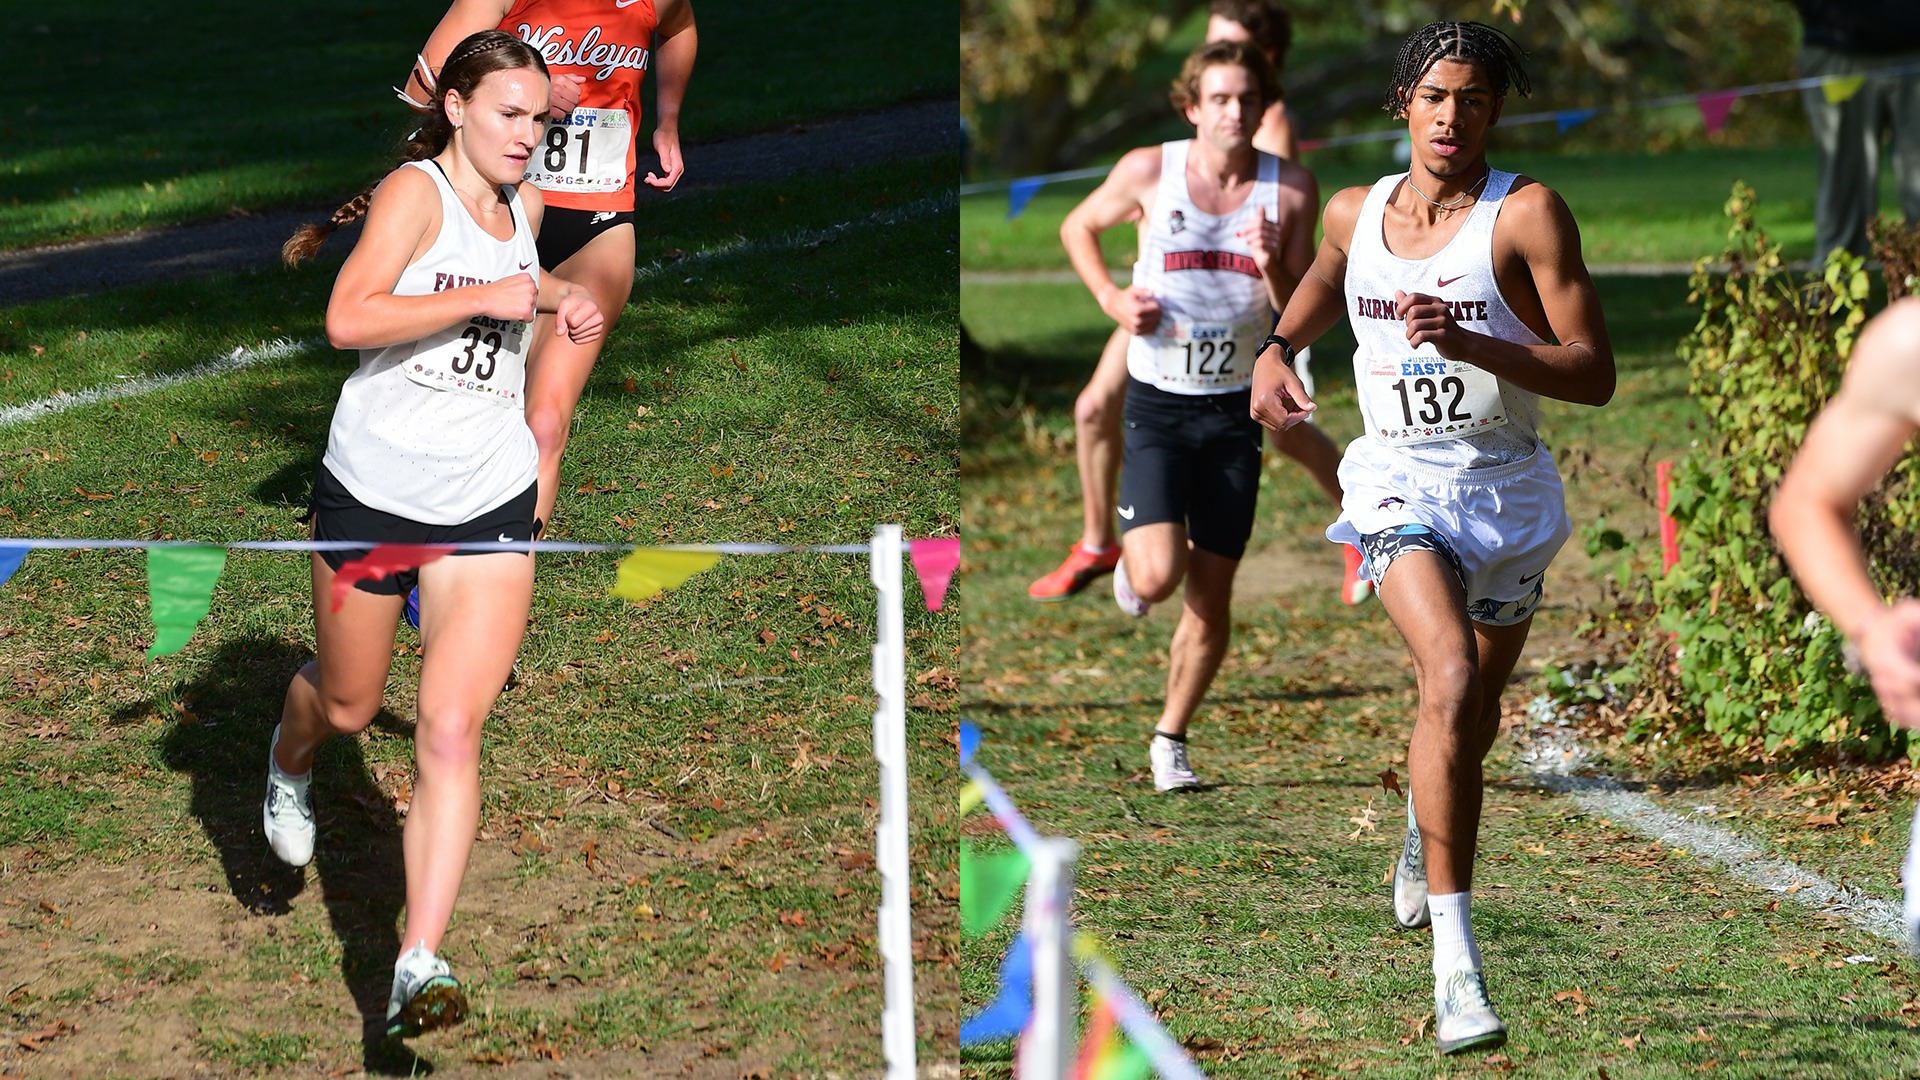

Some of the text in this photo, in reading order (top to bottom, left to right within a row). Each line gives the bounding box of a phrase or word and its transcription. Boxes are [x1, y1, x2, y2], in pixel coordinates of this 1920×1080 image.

[517, 23, 649, 81] Wesleyan
[543, 126, 591, 174] 81
[1442, 300, 1488, 321] TATE
[451, 326, 503, 381] 33
[1182, 341, 1236, 375] 122
[1401, 363, 1447, 376] EAST
[1392, 376, 1473, 427] 132
